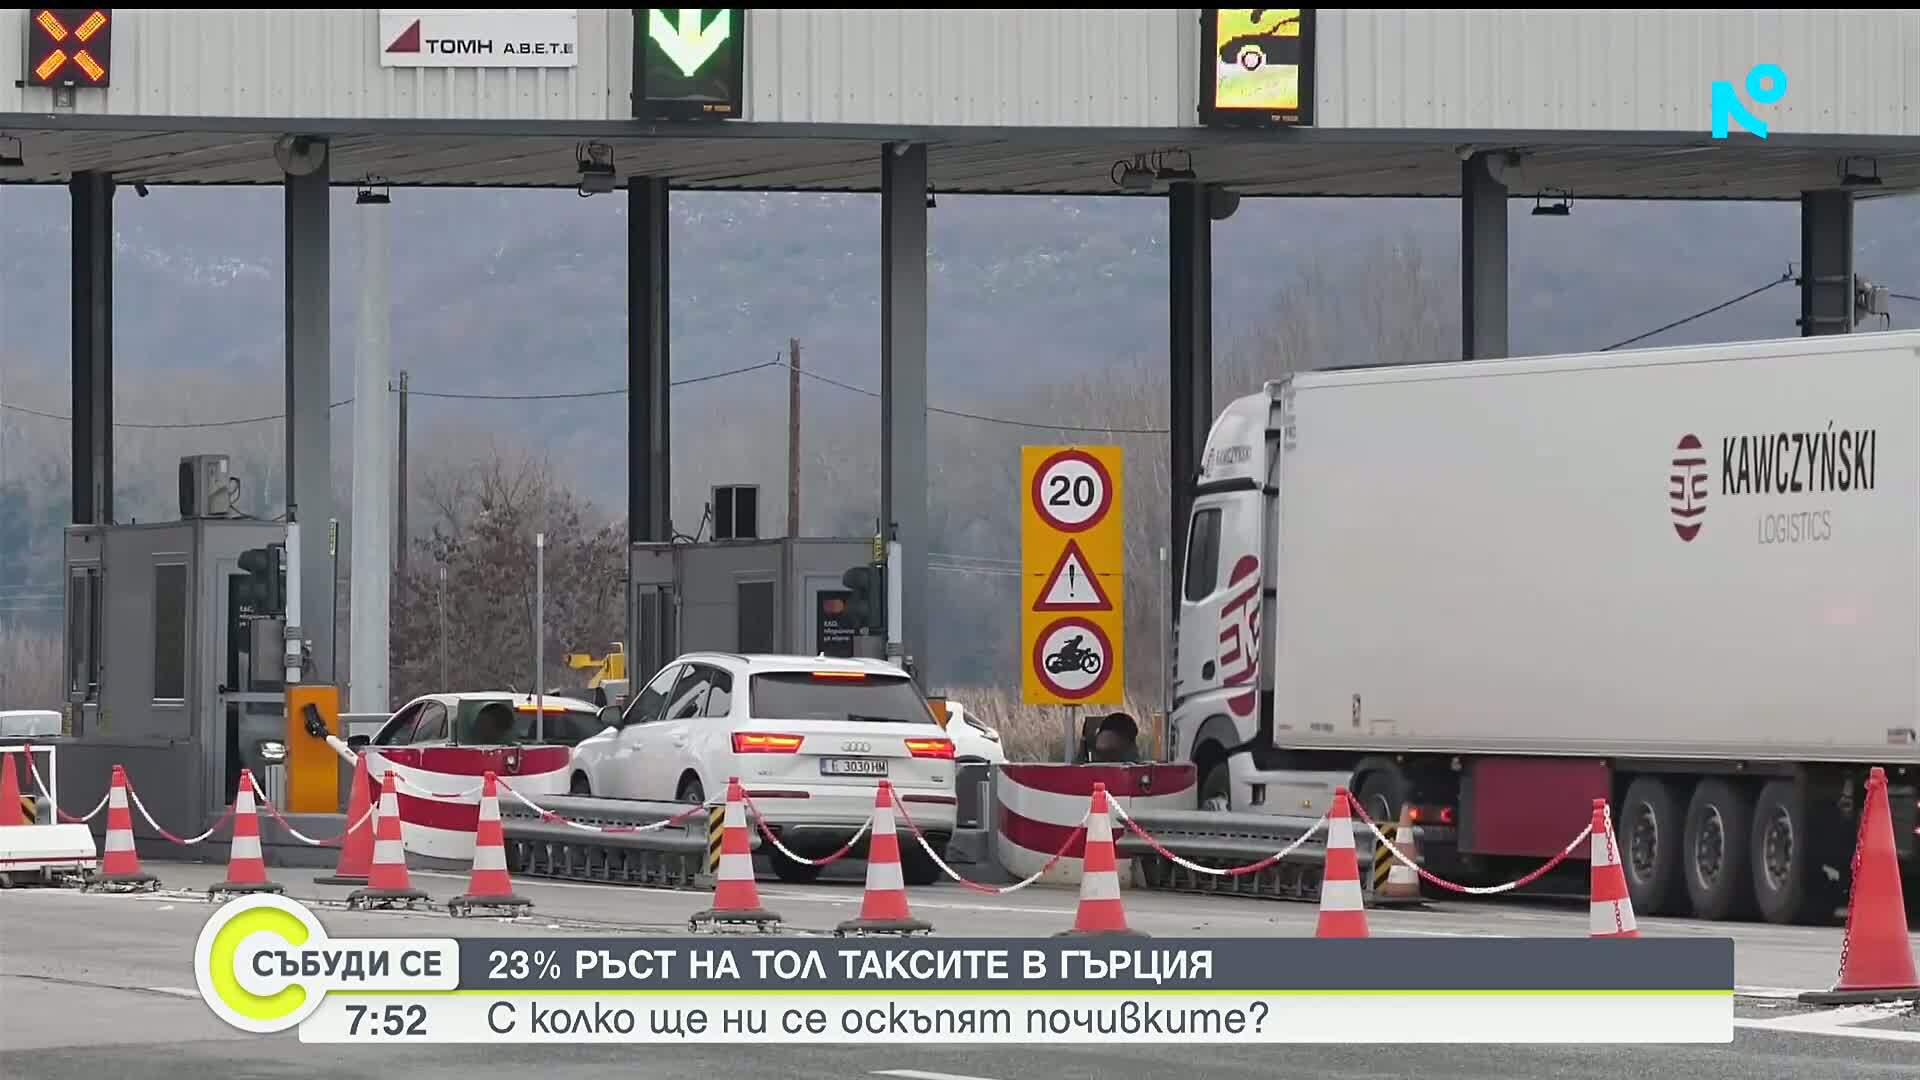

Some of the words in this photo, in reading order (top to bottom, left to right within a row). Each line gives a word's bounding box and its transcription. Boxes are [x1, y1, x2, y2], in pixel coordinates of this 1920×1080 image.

[1721, 420, 1876, 496] KAWCZYŃSKI
[1049, 475, 1095, 507] 20
[1757, 510, 1832, 545] LOGISTICS
